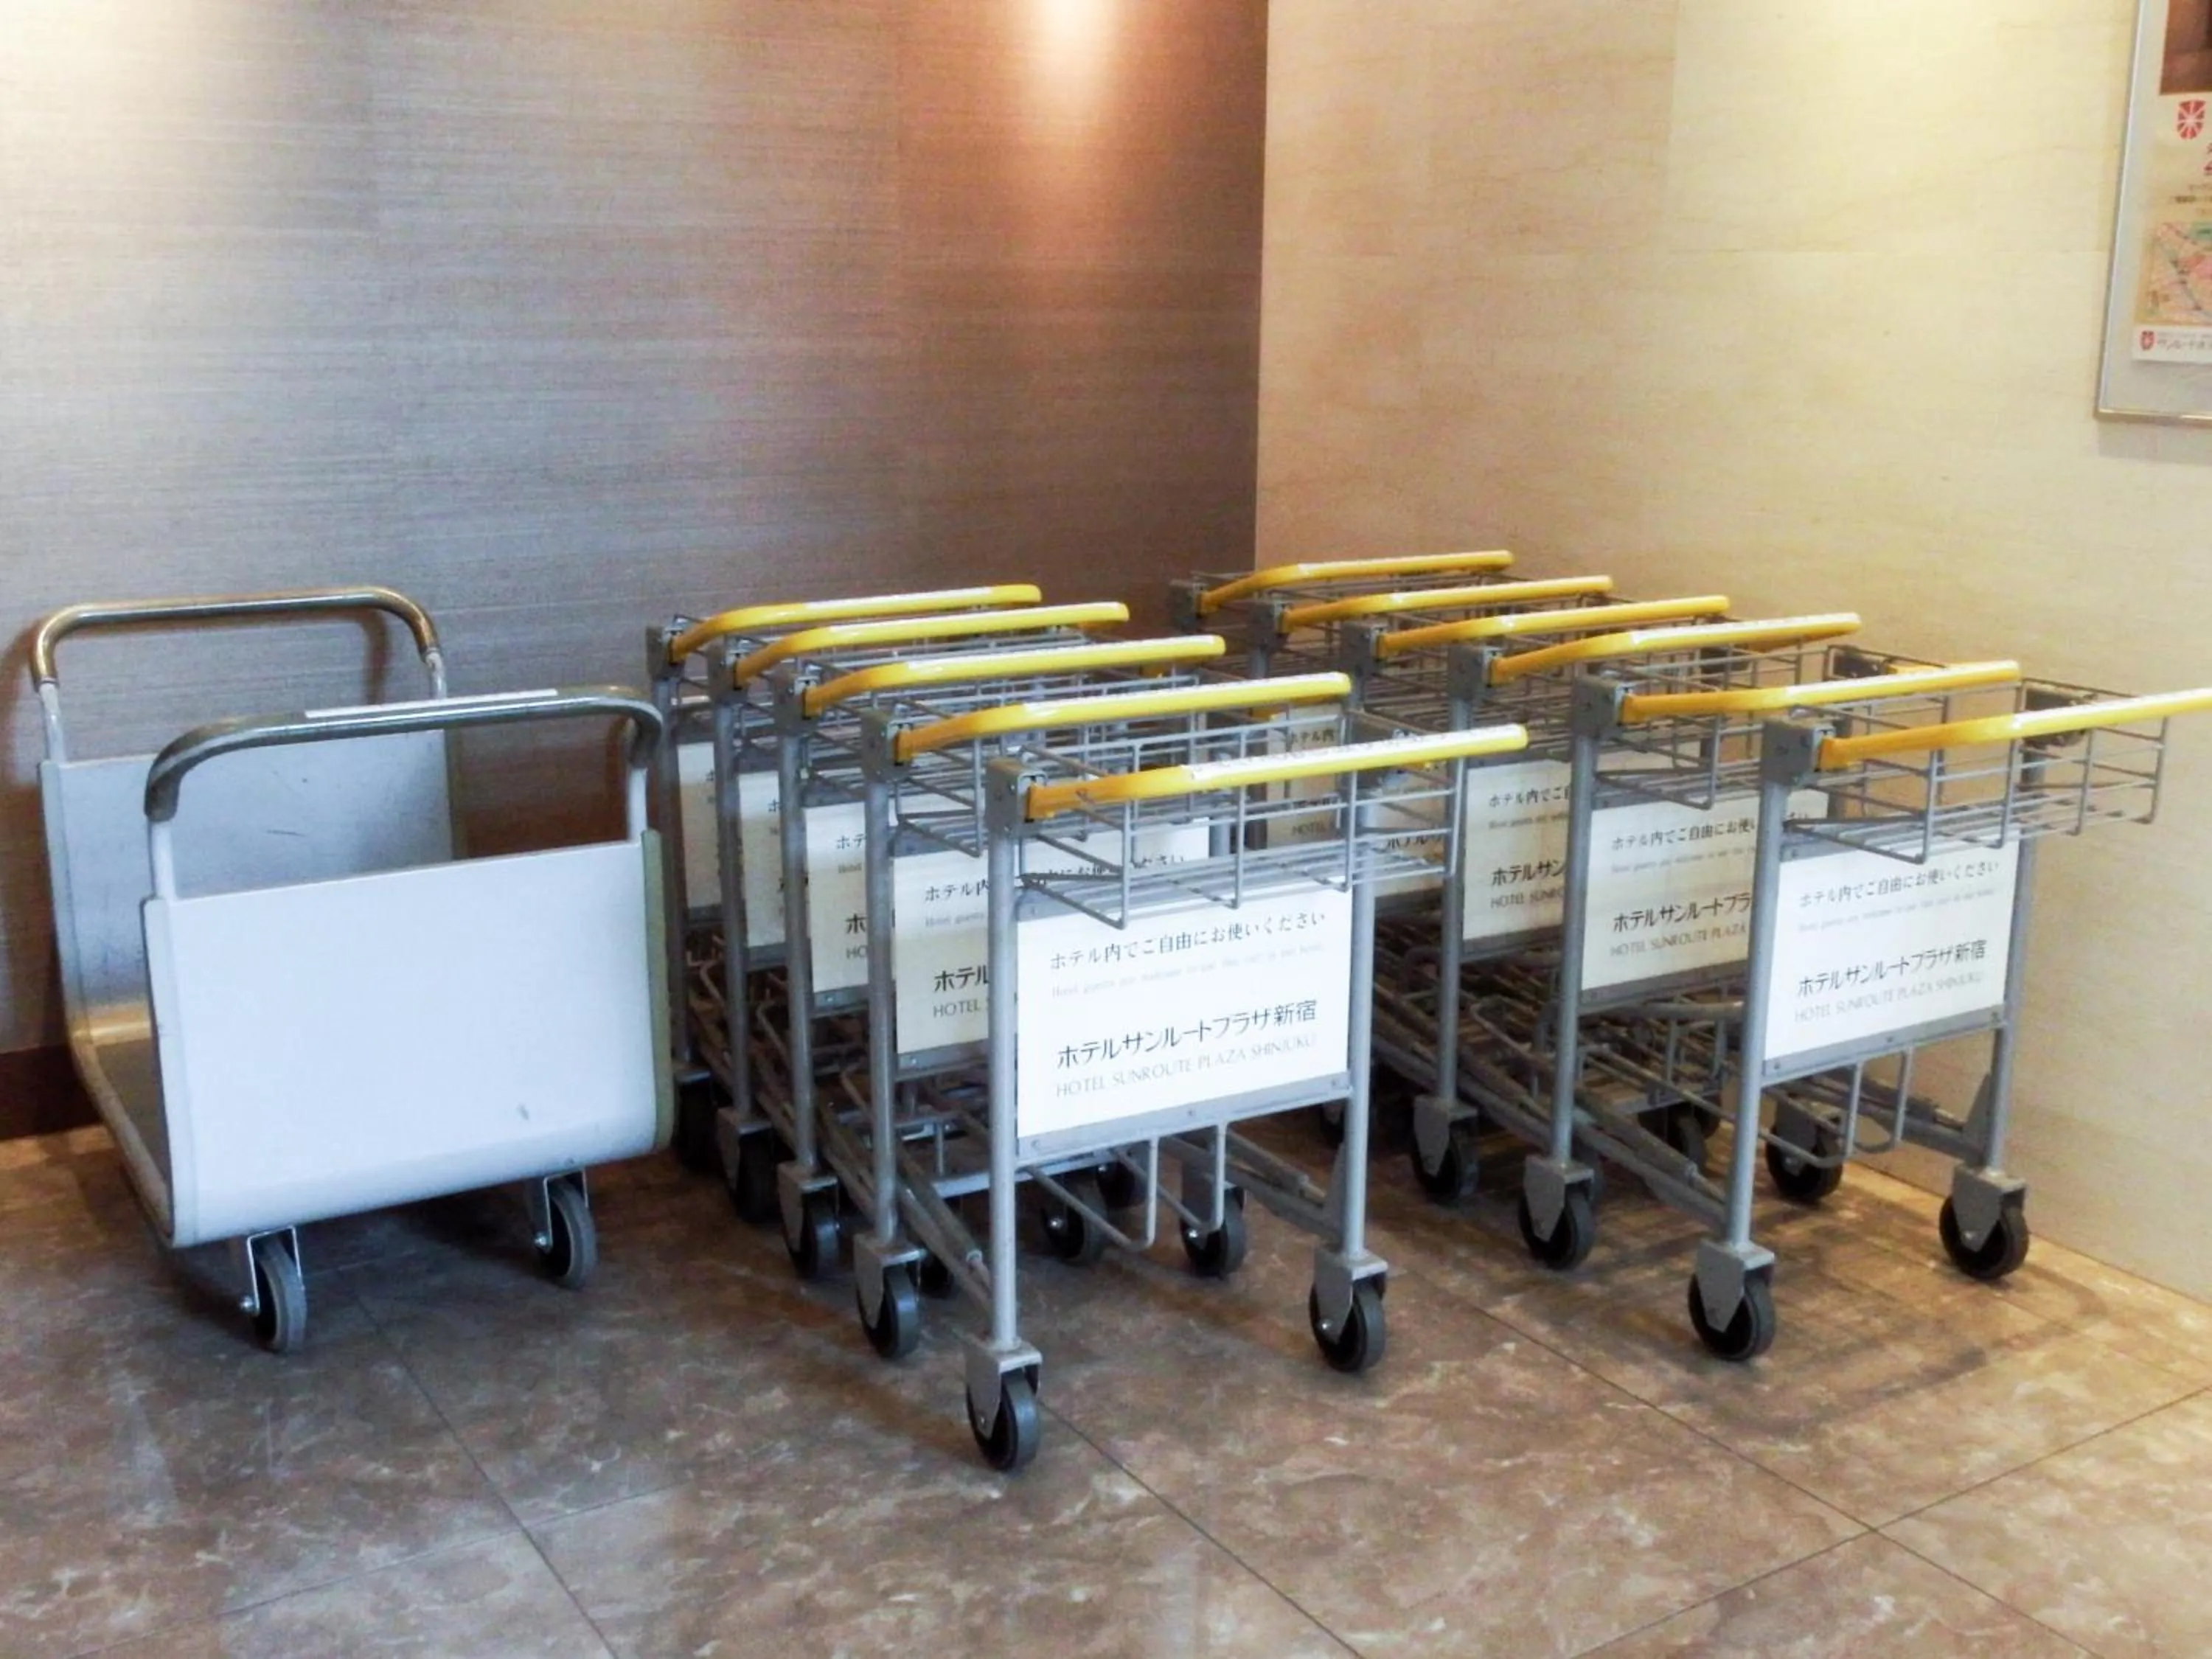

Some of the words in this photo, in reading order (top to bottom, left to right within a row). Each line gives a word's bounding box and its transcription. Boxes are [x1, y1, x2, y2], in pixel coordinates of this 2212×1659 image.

[933, 999, 981, 1018] HOTEL
[1057, 999, 1318, 1069] ホテルサンルートプラザ新宿
[1057, 1076, 1105, 1098] HOTEL
[1113, 1059, 1192, 1086] SUNROUTE
[1198, 1047, 1247, 1071] PLAZA
